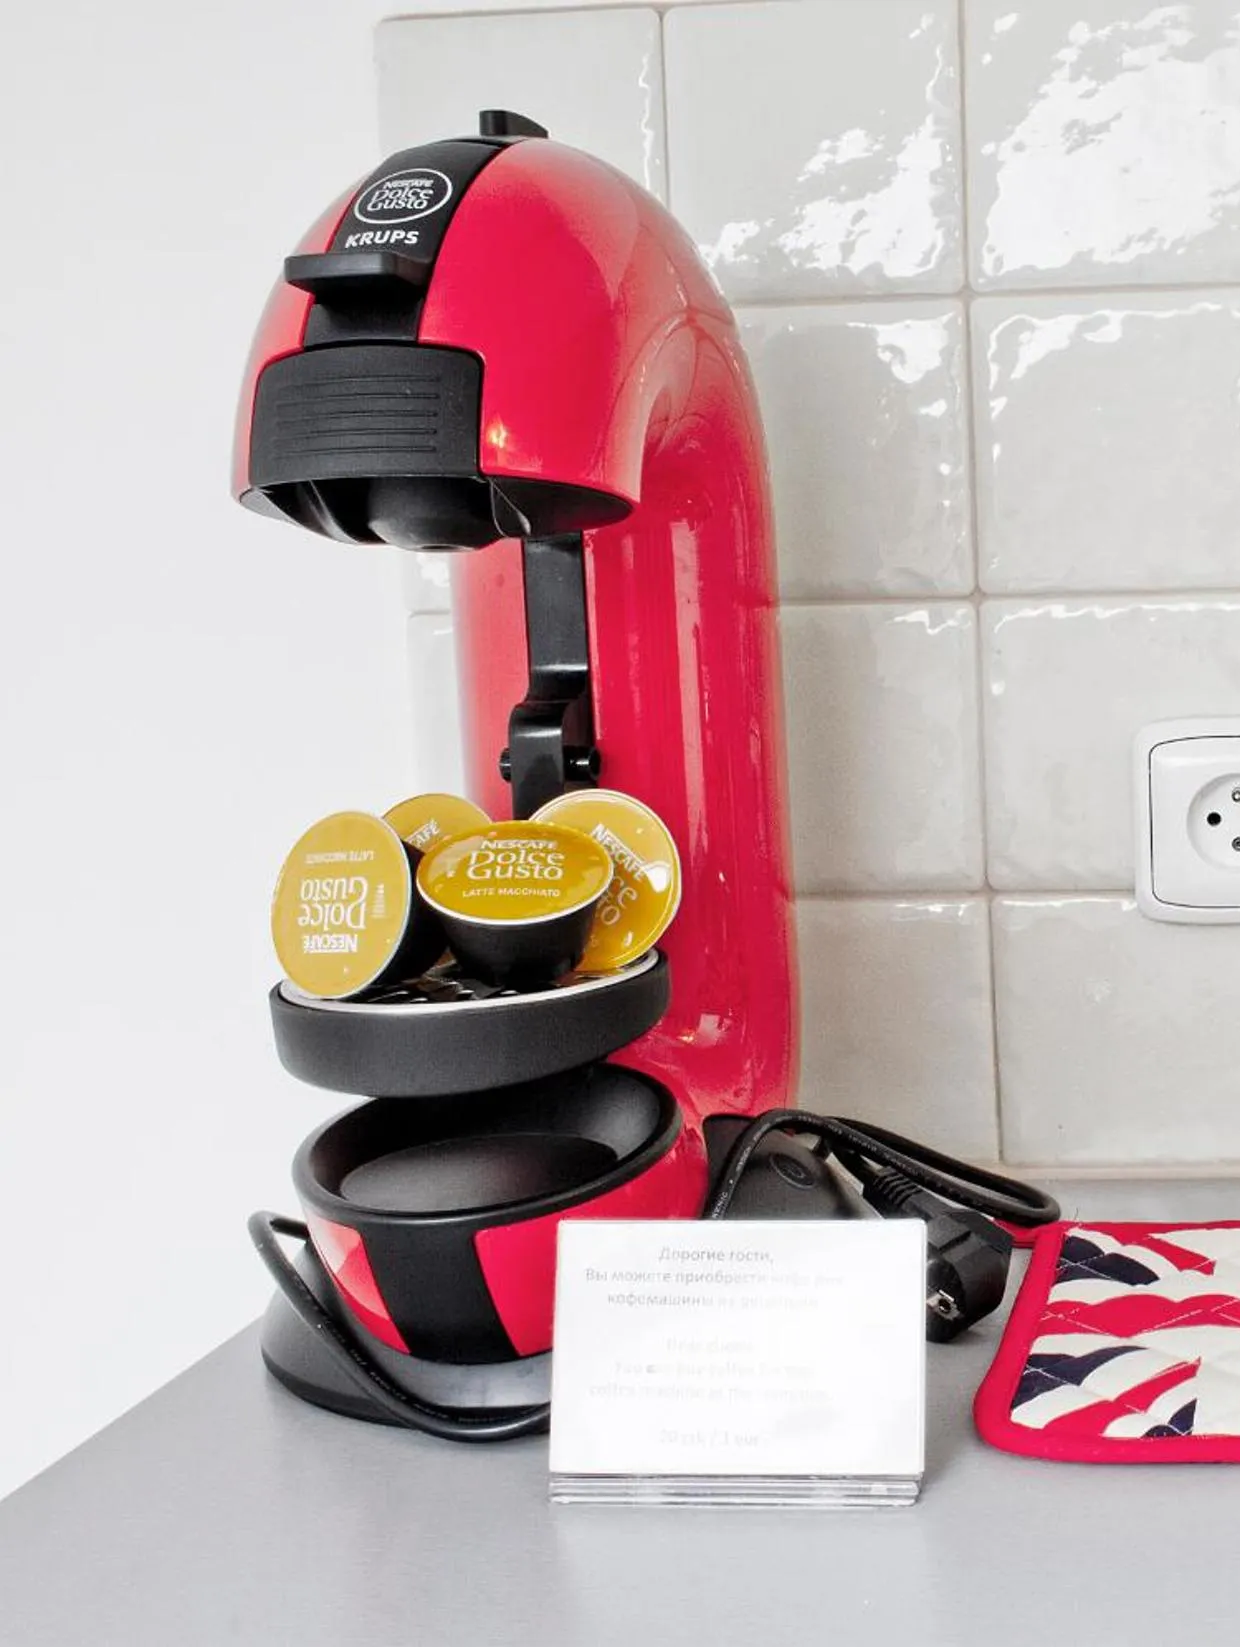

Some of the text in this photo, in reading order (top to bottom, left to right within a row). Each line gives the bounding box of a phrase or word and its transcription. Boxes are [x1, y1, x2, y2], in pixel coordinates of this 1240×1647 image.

[345, 230, 419, 248] KRUPS
[469, 849, 565, 866] Dolce
[466, 864, 564, 880] Gusto
[300, 876, 368, 902] Gusto
[462, 887, 495, 898] LATTE
[298, 902, 366, 931] Dolce
[658, 1247, 775, 1264] Дорогие гости,
[585, 1268, 608, 1282] Вы
[612, 1271, 672, 1283] можете
[675, 1269, 767, 1286] приобрести
[608, 1292, 714, 1308] кофемашины
